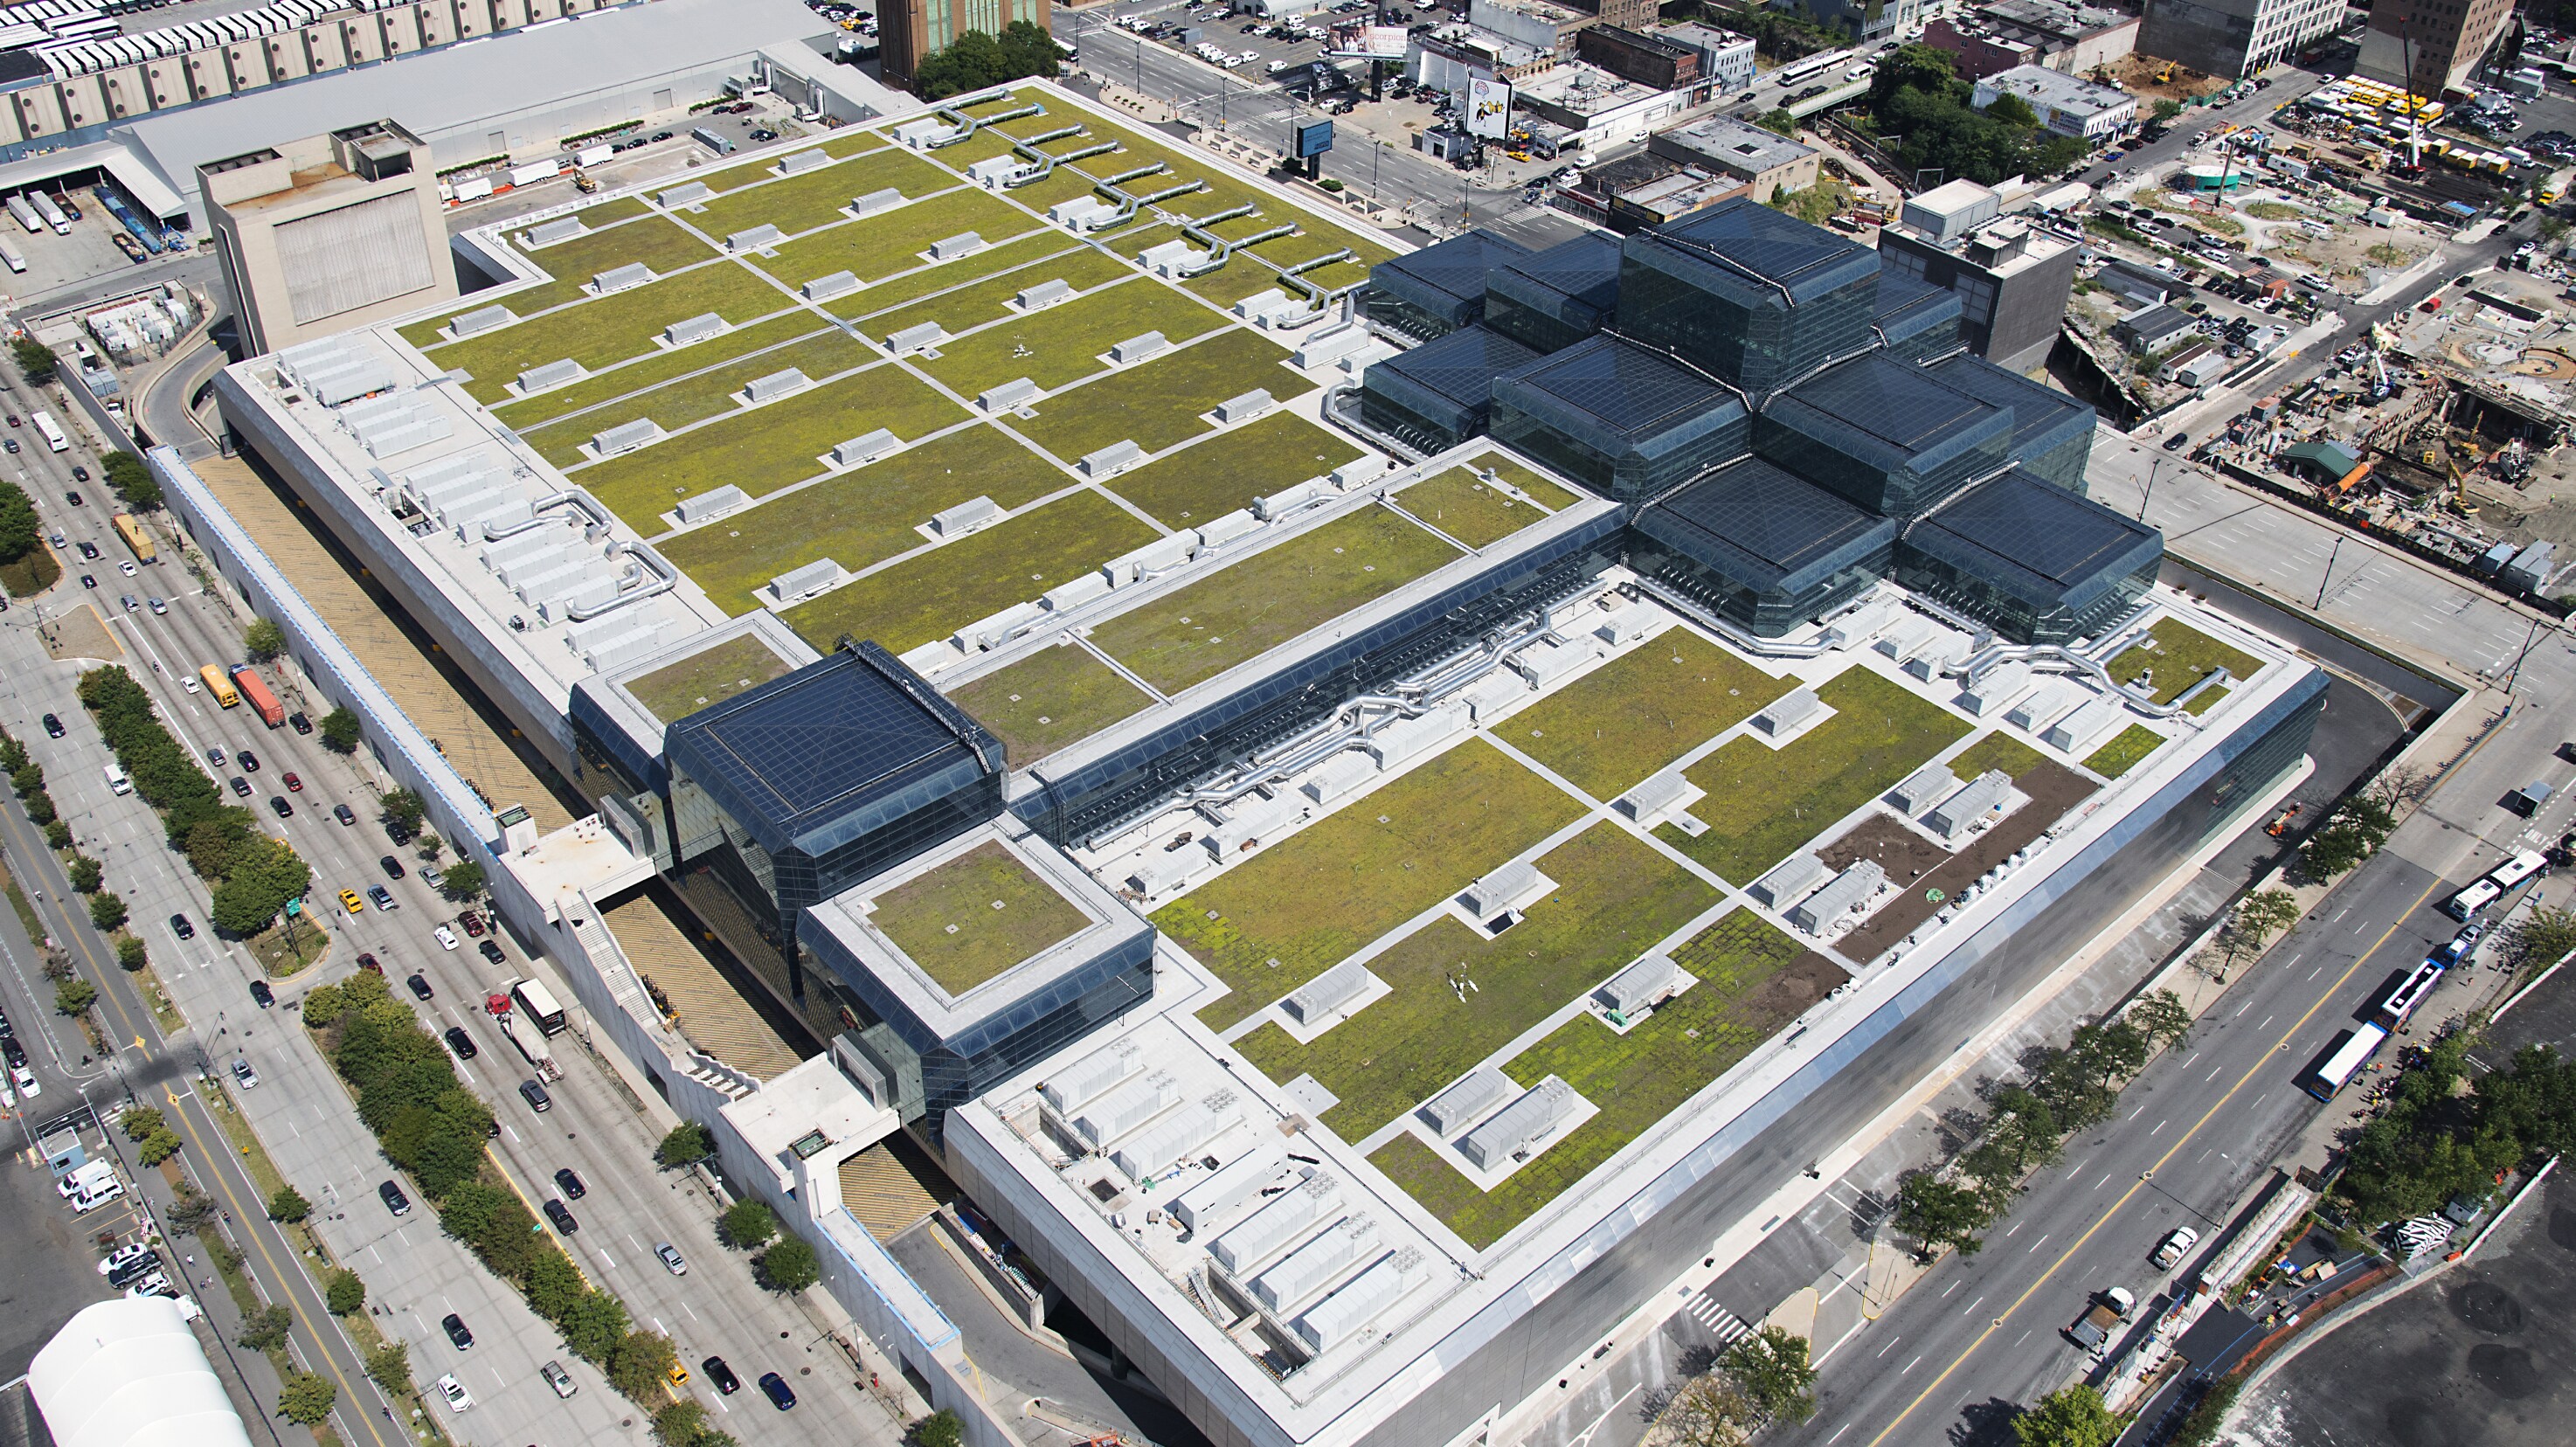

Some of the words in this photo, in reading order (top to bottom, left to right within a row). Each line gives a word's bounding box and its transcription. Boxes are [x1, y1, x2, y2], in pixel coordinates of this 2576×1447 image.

[2369, 525, 2392, 537] NEW
[2398, 537, 2434, 556] UNDER
[2442, 556, 2462, 569] THE
[2524, 829, 2549, 845] ONLY
